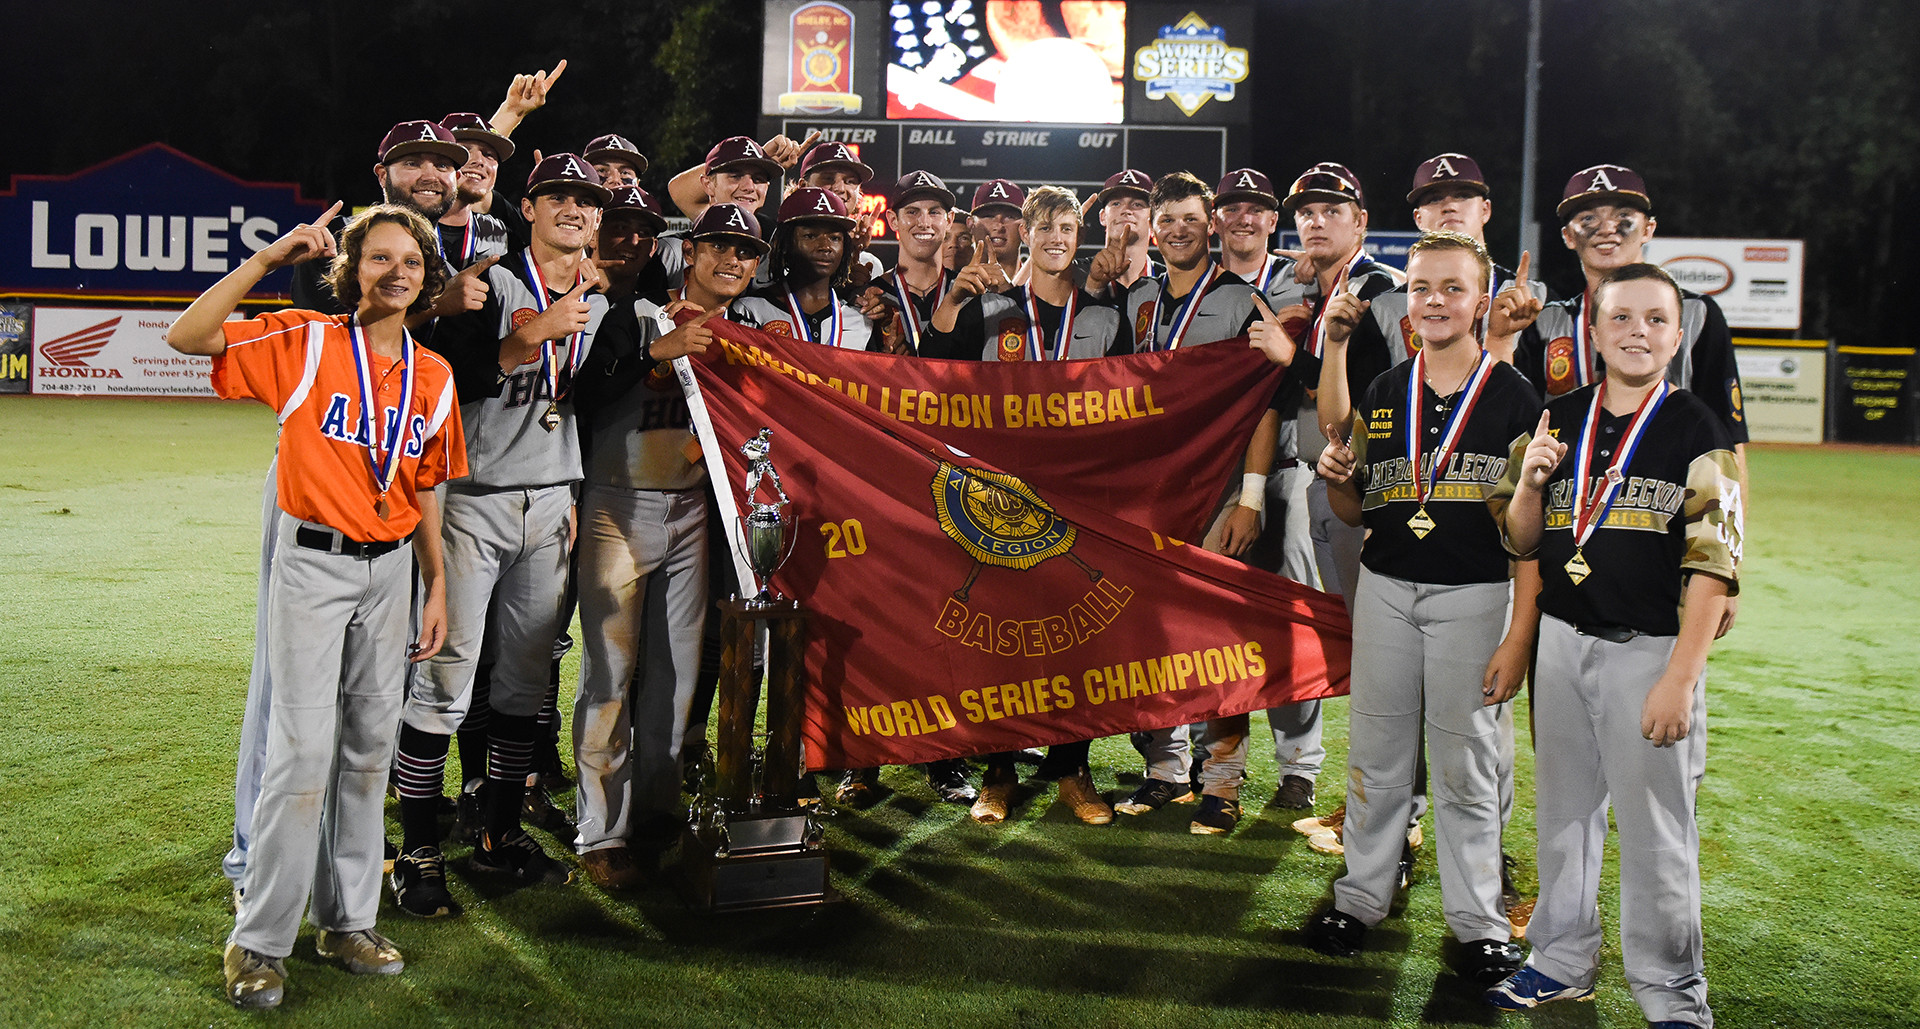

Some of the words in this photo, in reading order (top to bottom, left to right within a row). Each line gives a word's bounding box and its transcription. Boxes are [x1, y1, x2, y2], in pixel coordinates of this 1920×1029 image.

[1157, 43, 1226, 60] WORLD
[1137, 48, 1246, 79] SERIES
[420, 124, 438, 142] A
[804, 127, 878, 144] BATTER
[908, 130, 956, 146] BALL
[982, 131, 1050, 147] STRIKE
[1078, 132, 1117, 148] OUT
[605, 135, 625, 150] A
[743, 140, 763, 159] A
[834, 144, 854, 163] A
[561, 157, 587, 180] A
[1431, 157, 1459, 178] A
[914, 171, 936, 188] A
[1119, 169, 1140, 186] A
[1235, 171, 1258, 189] A
[1586, 169, 1618, 192] A
[624, 187, 648, 208] A
[989, 181, 1010, 199] A
[813, 192, 836, 214] A
[725, 207, 750, 231] A
[31, 200, 279, 273] LOWE'S
[138, 320, 170, 329] Honda
[132, 356, 169, 367] Serving
[171, 357, 187, 366] the
[38, 367, 124, 379] HONDA
[160, 370, 181, 378] over
[182, 370, 194, 378] 45
[196, 371, 211, 380] yea
[879, 386, 994, 429] LEGION
[1002, 384, 1165, 429] BASEBALL
[1371, 408, 1394, 419] UTY
[1370, 421, 1393, 430] ONOR
[1367, 431, 1392, 439] OUNTRY
[1445, 452, 1509, 483] LEGIO
[1616, 476, 1687, 515] LEGION
[819, 518, 868, 559] 20
[977, 529, 1062, 555] LEGION
[934, 577, 1135, 657] BASEBALL
[844, 694, 958, 738] WORLD
[959, 674, 1076, 724] SERIES
[1082, 641, 1268, 706] CHAMPIONS
